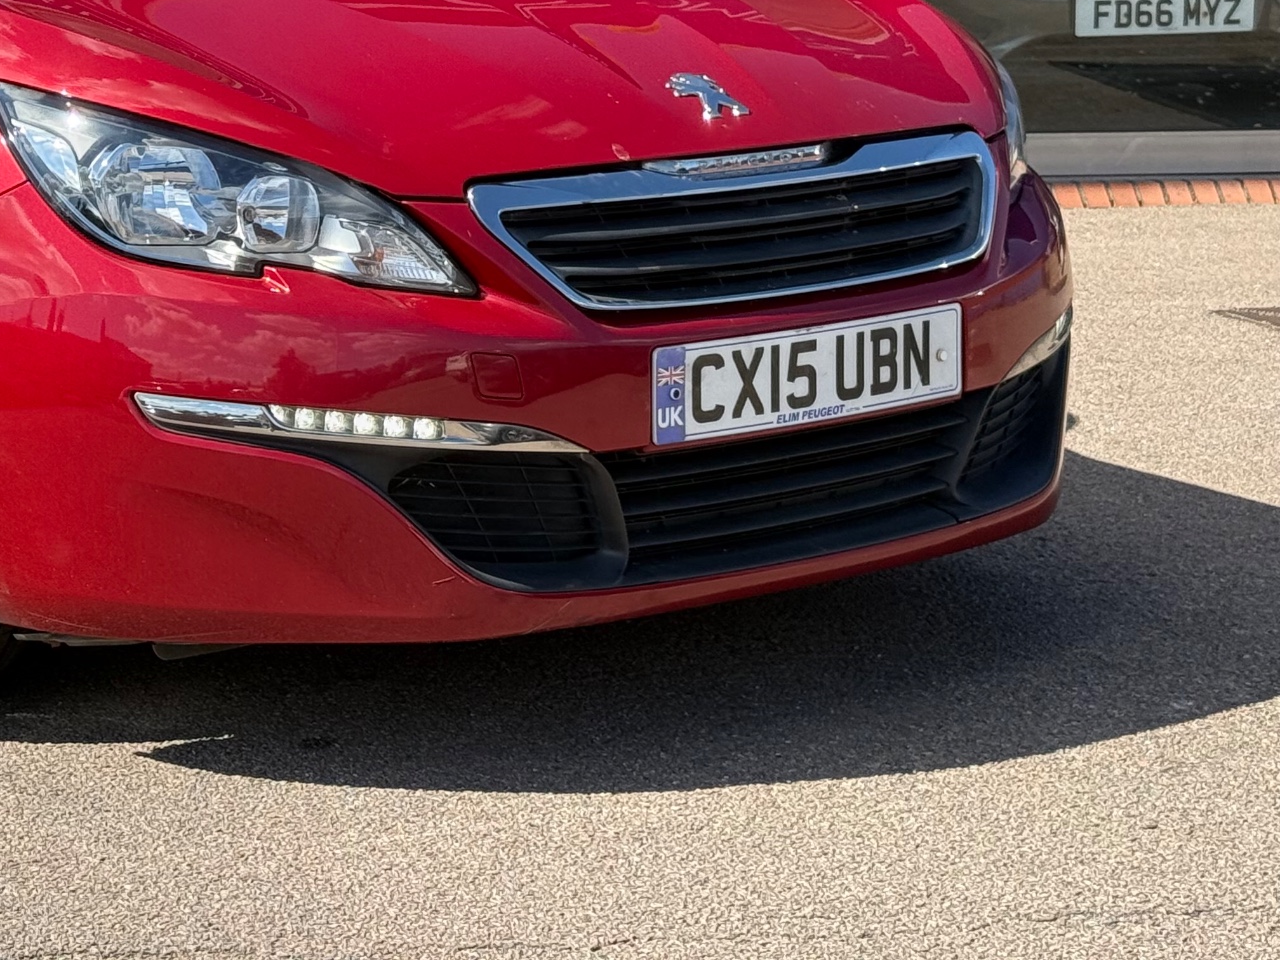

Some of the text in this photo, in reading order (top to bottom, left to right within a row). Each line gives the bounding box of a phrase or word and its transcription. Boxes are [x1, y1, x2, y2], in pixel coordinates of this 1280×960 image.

[691, 320, 931, 424] CX15 UBN
[657, 405, 684, 429] UK
[776, 411, 801, 425] ELIM
[802, 404, 846, 422] PEUGEOT
